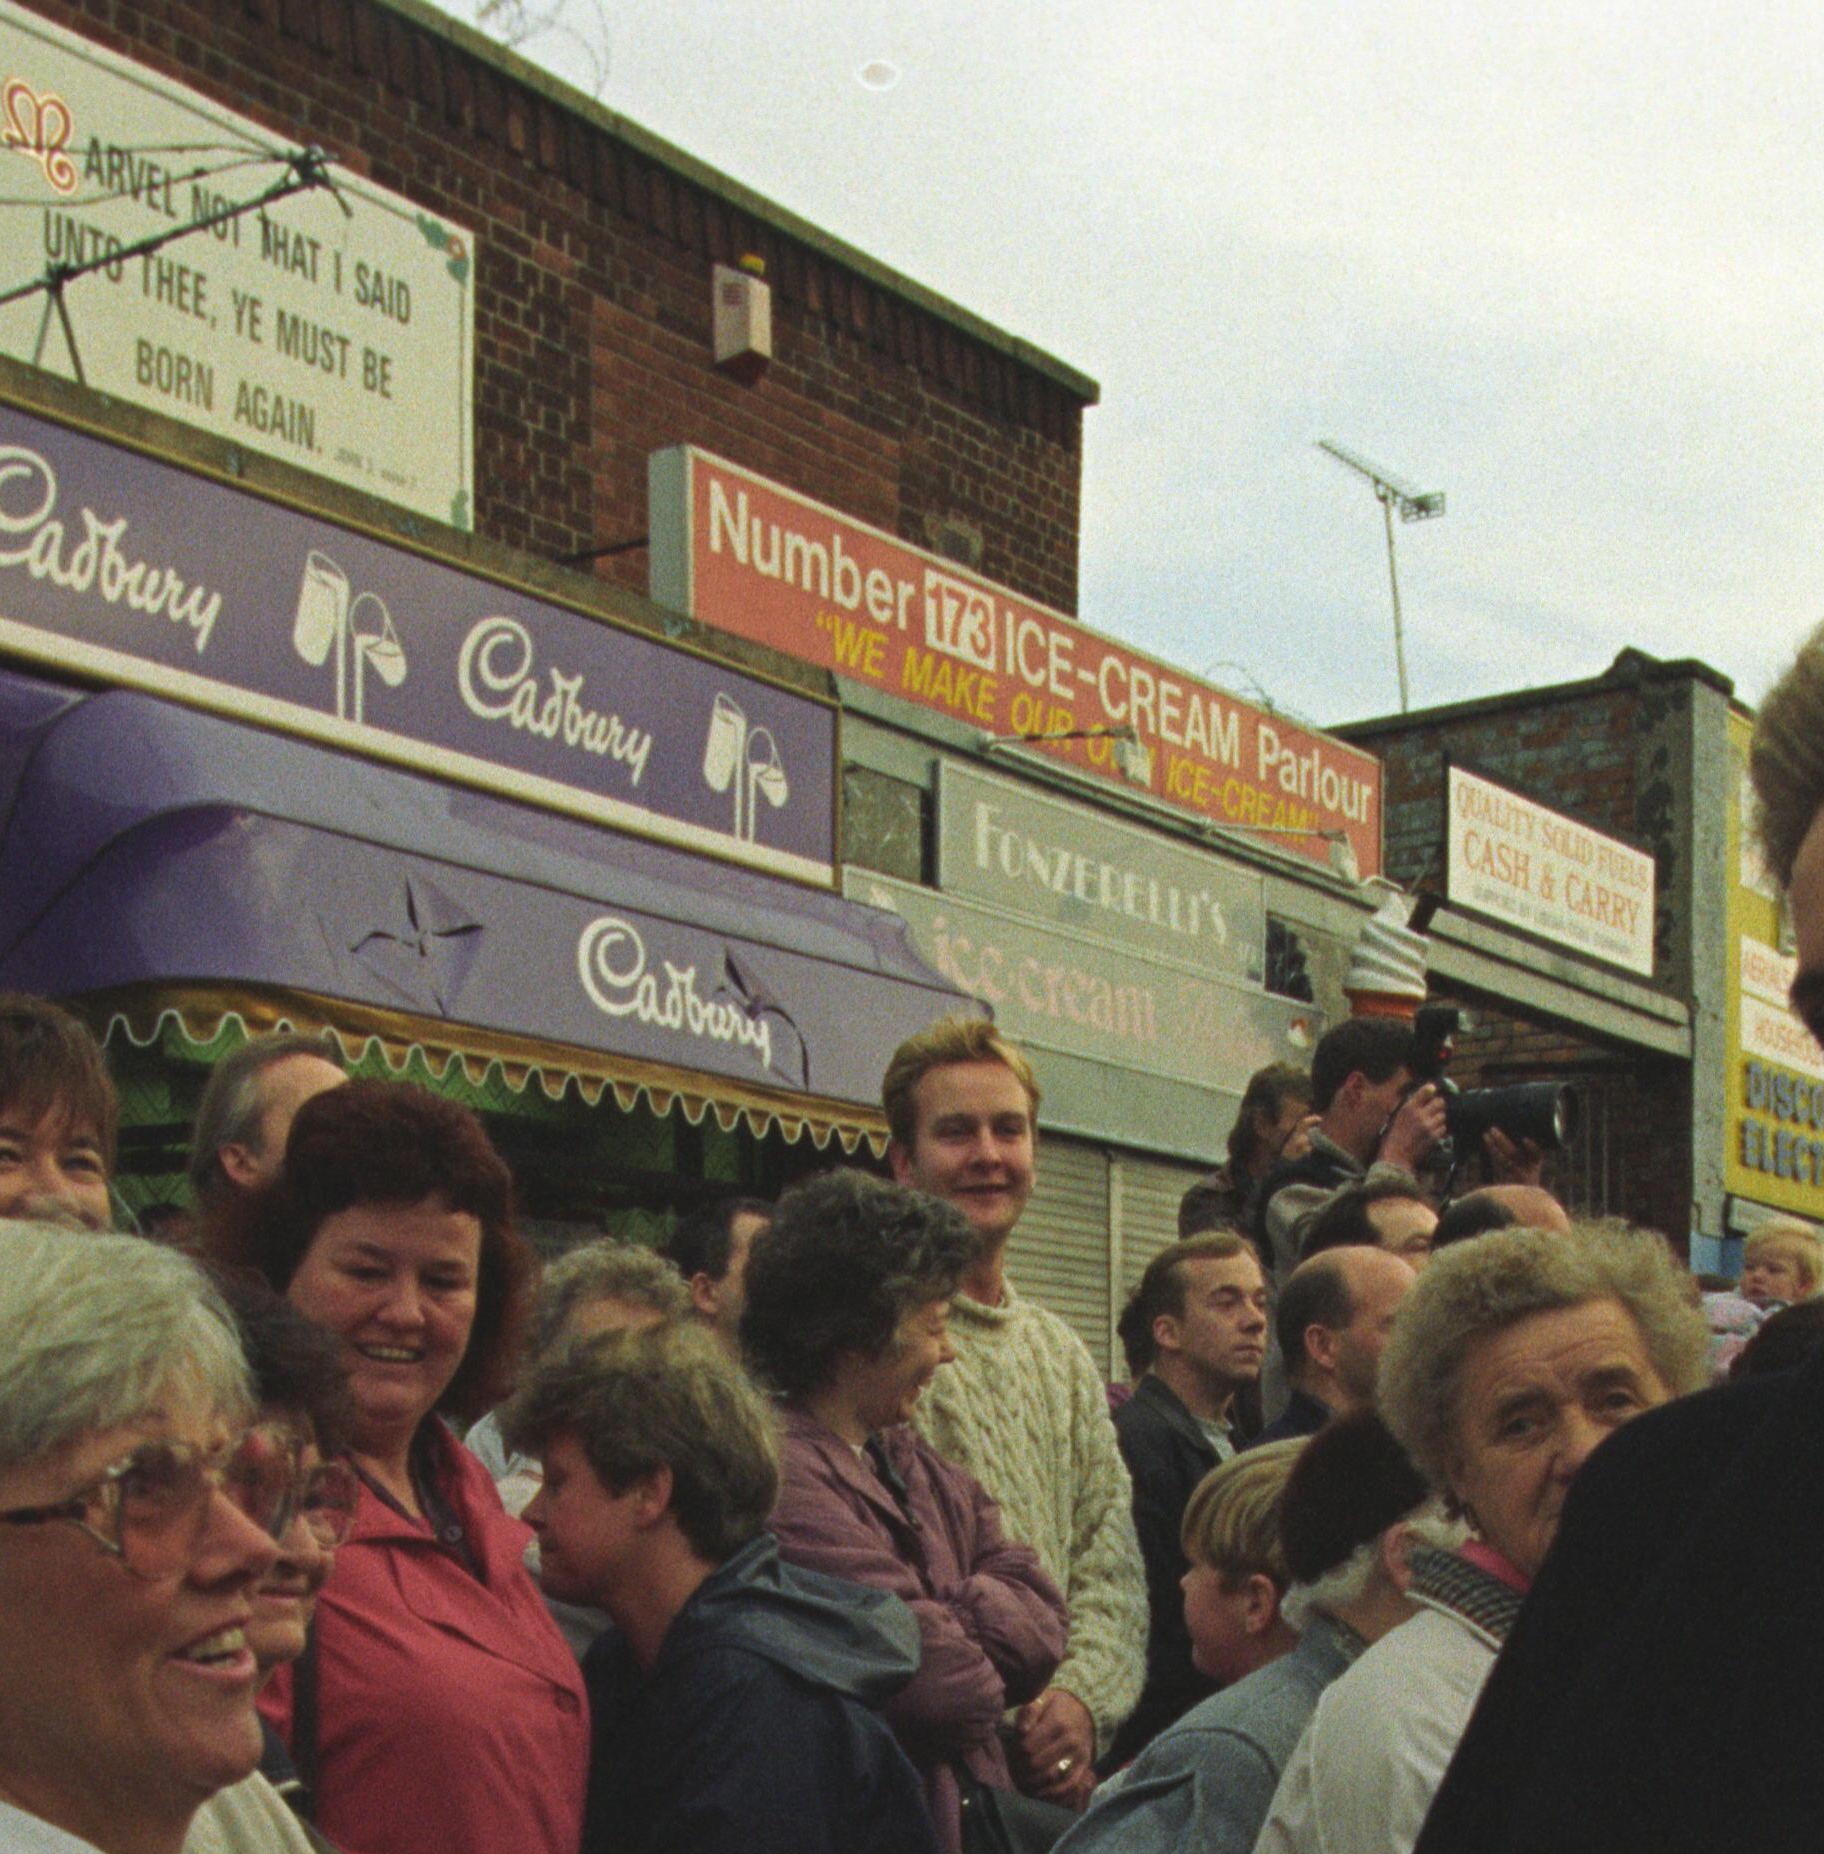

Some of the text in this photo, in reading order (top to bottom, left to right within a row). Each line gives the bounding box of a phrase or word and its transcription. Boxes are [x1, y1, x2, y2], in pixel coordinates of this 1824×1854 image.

[44, 207, 393, 399] UNTO THEE, YE MUST BE
[258, 205, 321, 283] THAT
[333, 249, 343, 294] I
[355, 261, 412, 325] SAID
[136, 339, 323, 454] BORN AGAIN.
[457, 615, 652, 787] Cadbury
[709, 479, 916, 631] Number
[927, 572, 995, 668] 173
[1005, 611, 1241, 768] ICE-CREAM
[1258, 723, 1373, 823] Parlour
[902, 645, 999, 722] MAKE
[1011, 692, 1075, 752] OUR
[1464, 829, 1532, 891] CASH
[1540, 862, 1556, 902] &
[1565, 872, 1642, 936] CARRY
[578, 917, 773, 1068] Cadbury
